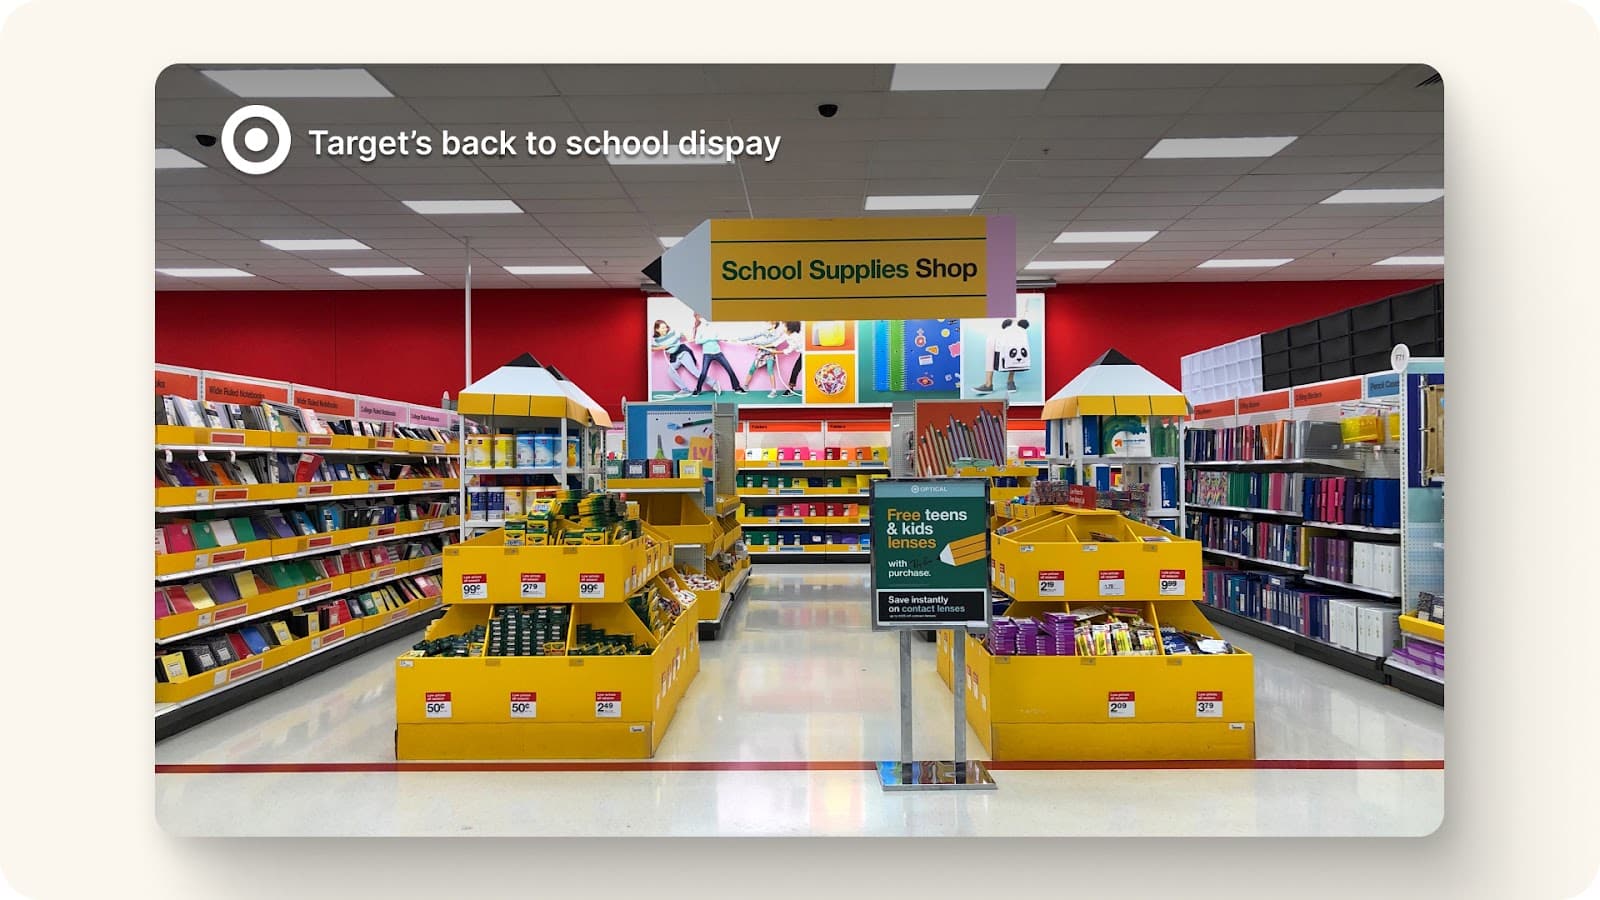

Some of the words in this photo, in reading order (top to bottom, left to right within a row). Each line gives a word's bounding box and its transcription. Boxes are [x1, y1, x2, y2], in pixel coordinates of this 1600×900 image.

[722, 260, 802, 281] School
[809, 259, 909, 284] Supplies
[916, 258, 978, 282] Shop
[209, 386, 222, 395] Wide
[223, 387, 238, 397] Ruled
[240, 390, 265, 399] Notebooks
[887, 509, 921, 521] Free
[925, 509, 968, 521] teens
[887, 522, 898, 535] &
[902, 522, 934, 535] kids
[888, 536, 937, 549] lenses
[888, 560, 908, 568] with
[888, 569, 932, 579] purchase.
[888, 595, 910, 604] Save
[911, 595, 949, 605] instantly
[902, 605, 935, 613] contact
[937, 605, 966, 613] lenses
